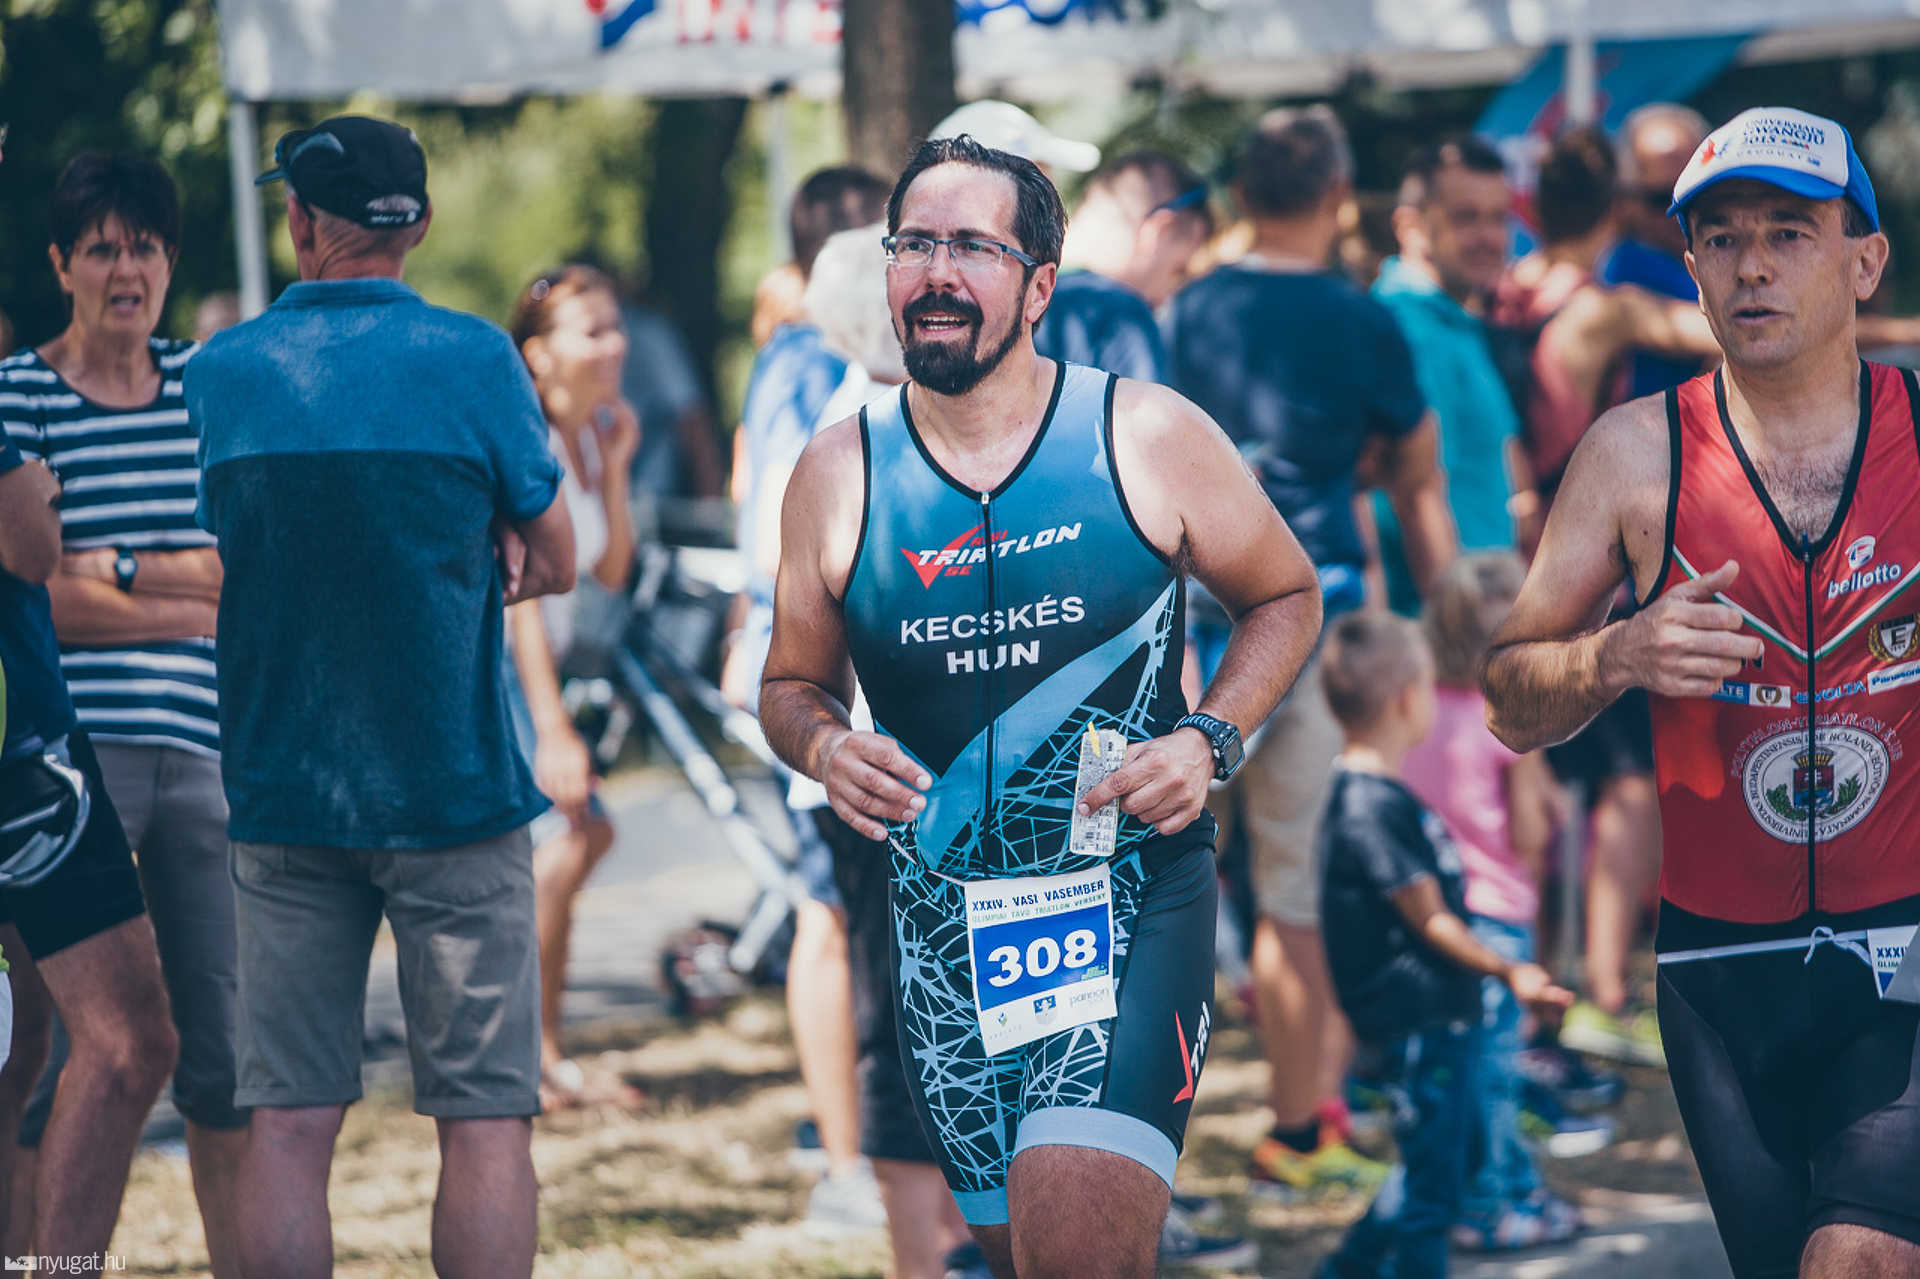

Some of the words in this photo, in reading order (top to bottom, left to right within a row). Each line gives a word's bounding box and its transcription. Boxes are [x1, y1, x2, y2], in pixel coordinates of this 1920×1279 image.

[917, 521, 1082, 566] TRIATLON
[1826, 561, 1902, 600] bellotto
[901, 593, 1086, 645] KECSKÉS
[946, 640, 1040, 674] HUN
[1012, 894, 1039, 907] VASI
[1044, 879, 1105, 901] VASEMBER
[987, 929, 1097, 987] 308
[1876, 946, 1907, 958] XXXI
